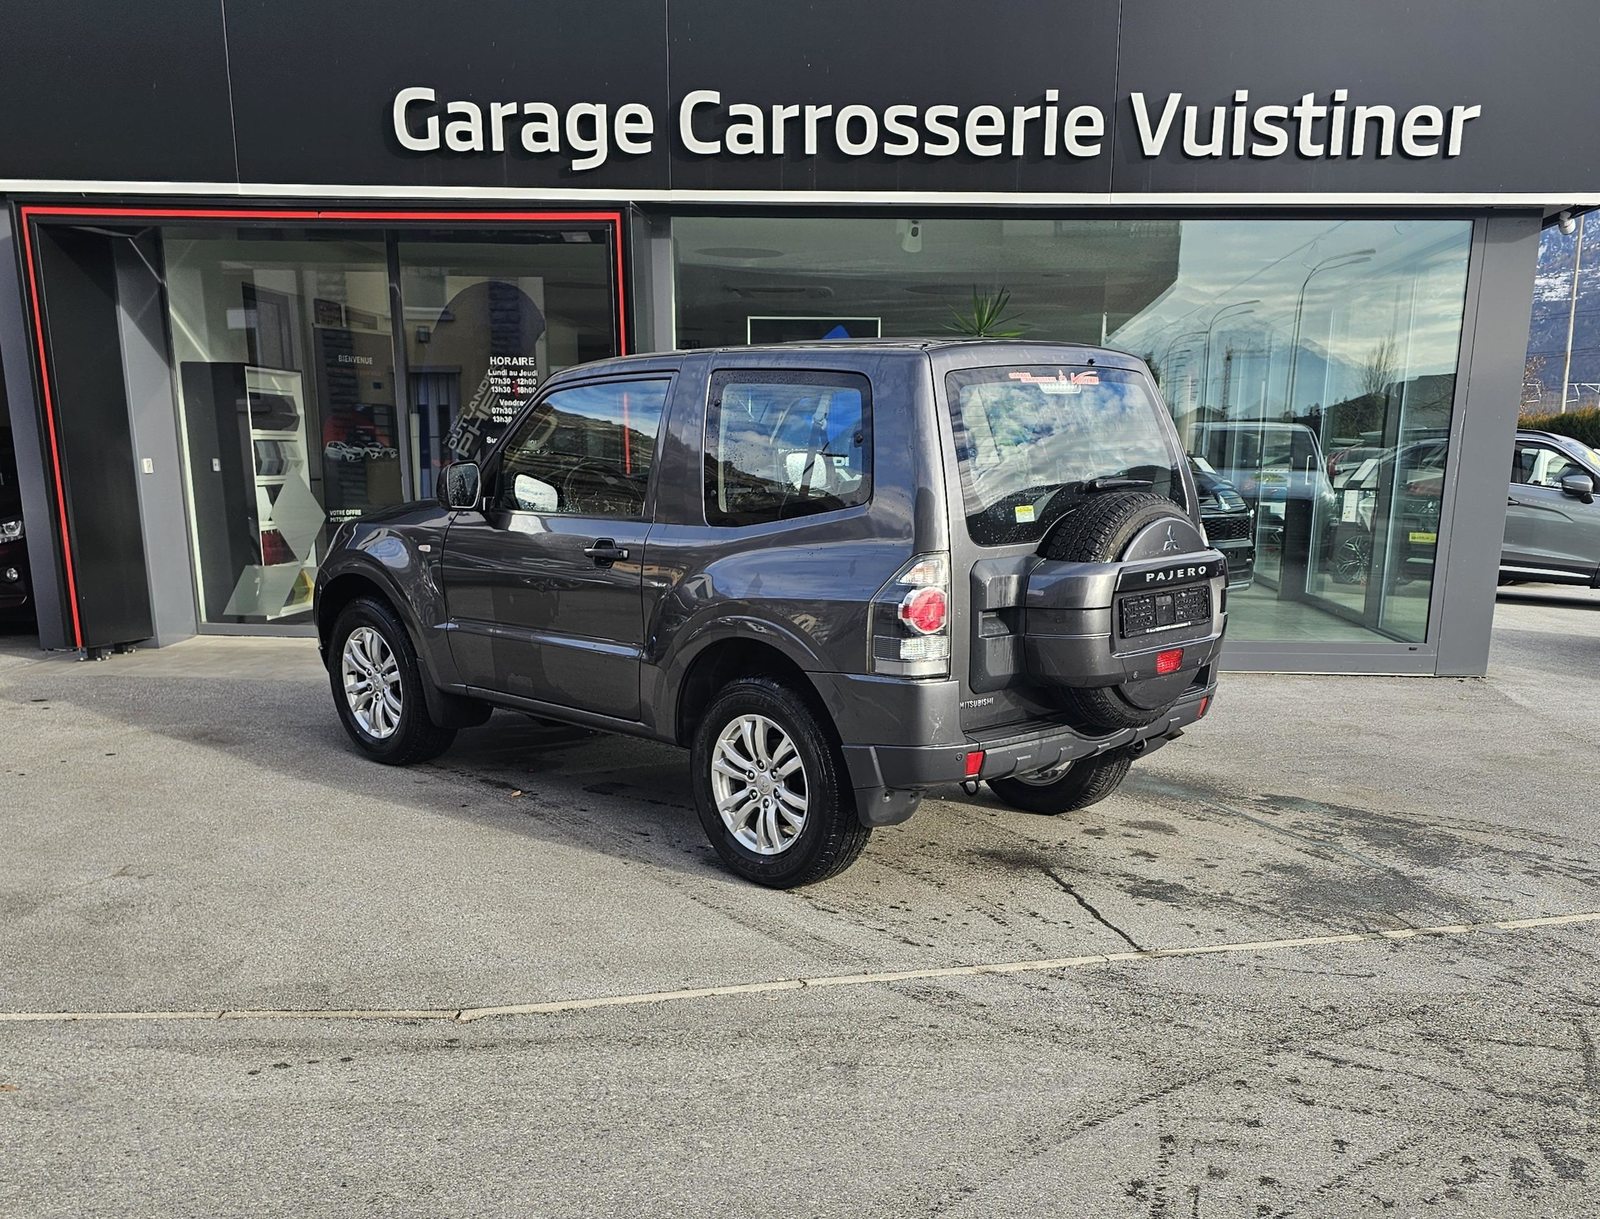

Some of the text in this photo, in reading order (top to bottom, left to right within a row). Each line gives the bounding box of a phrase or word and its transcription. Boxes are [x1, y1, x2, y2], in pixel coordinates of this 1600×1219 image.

[393, 86, 1482, 171] Garage Carrosserie Vuistiner
[338, 354, 373, 365] BIENVENUE
[489, 356, 535, 366] HORAIRE
[487, 368, 508, 377] Lundi
[518, 369, 538, 377] Jeudi
[491, 407, 513, 415] 07h30
[1145, 565, 1207, 583] PAJERO
[959, 697, 994, 709] MITSUBISHI
